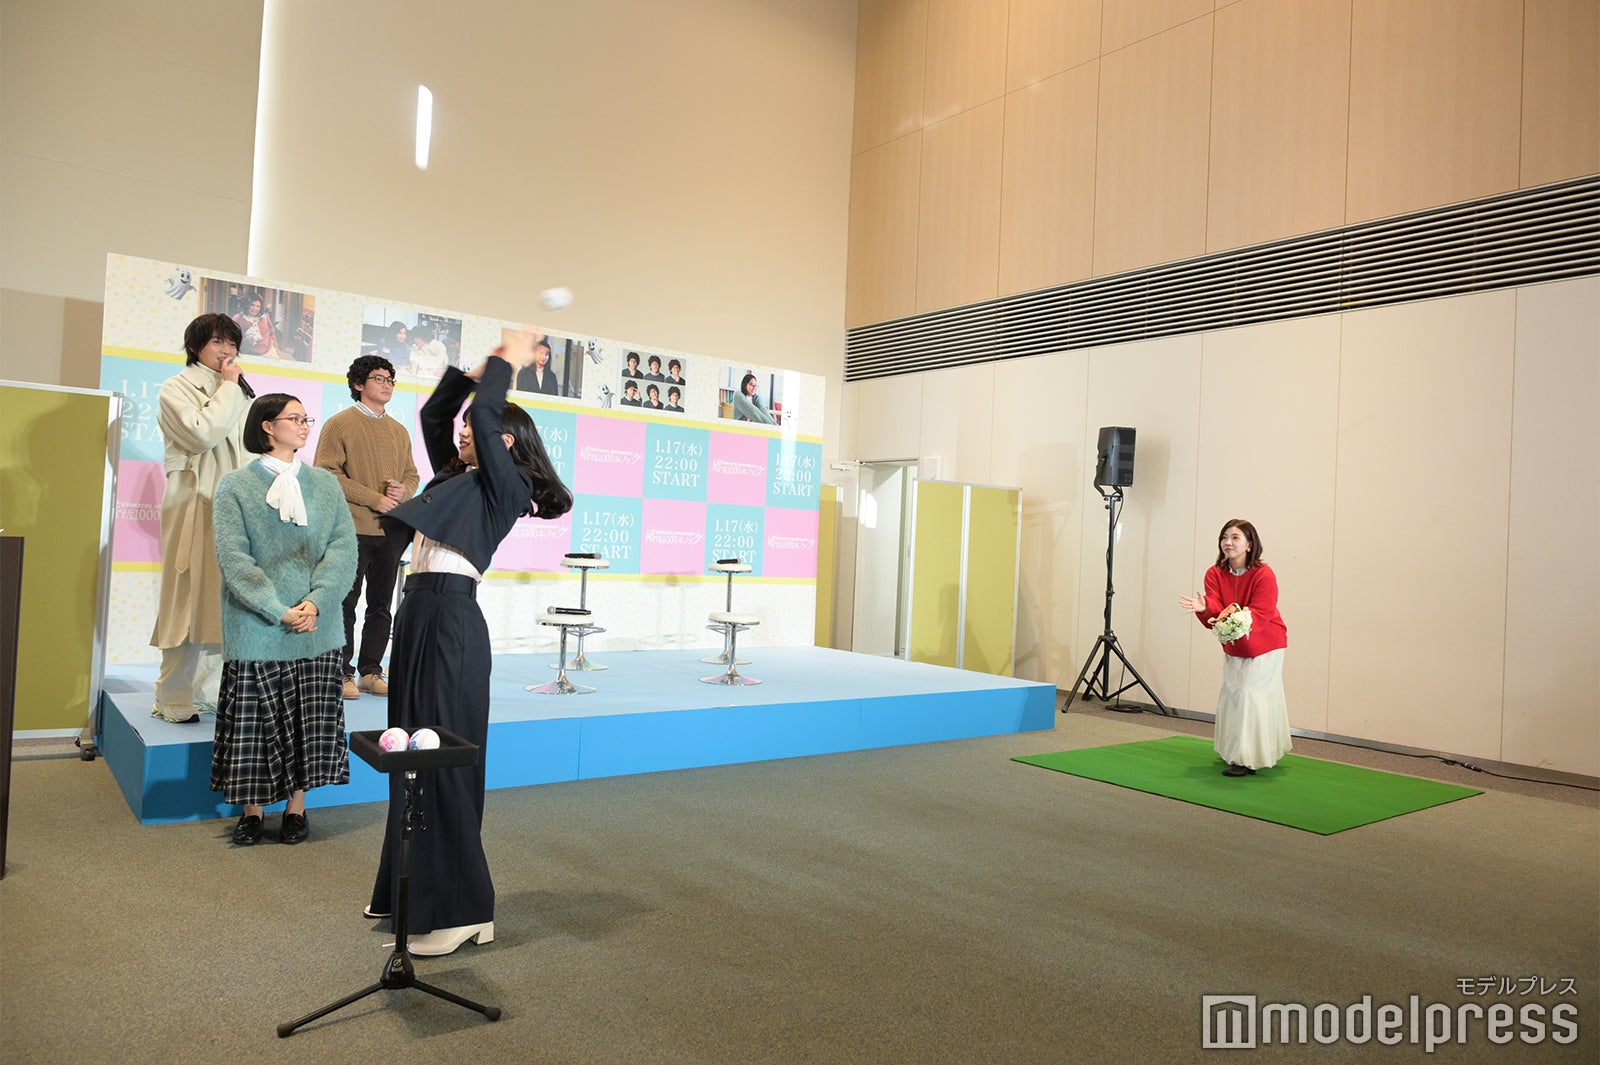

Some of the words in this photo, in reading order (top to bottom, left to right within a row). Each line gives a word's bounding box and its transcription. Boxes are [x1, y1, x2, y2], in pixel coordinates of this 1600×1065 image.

[120, 421, 164, 442] STA
[655, 439, 703, 457] 1.17(水)
[654, 455, 699, 472] 22:00
[652, 470, 701, 488] START
[774, 468, 812, 483] 22:00
[773, 481, 814, 497] START
[583, 510, 635, 527] 1.17(水)
[714, 518, 759, 534] 1.17(水)
[581, 527, 630, 544] 22:00
[713, 534, 755, 549] 22:00
